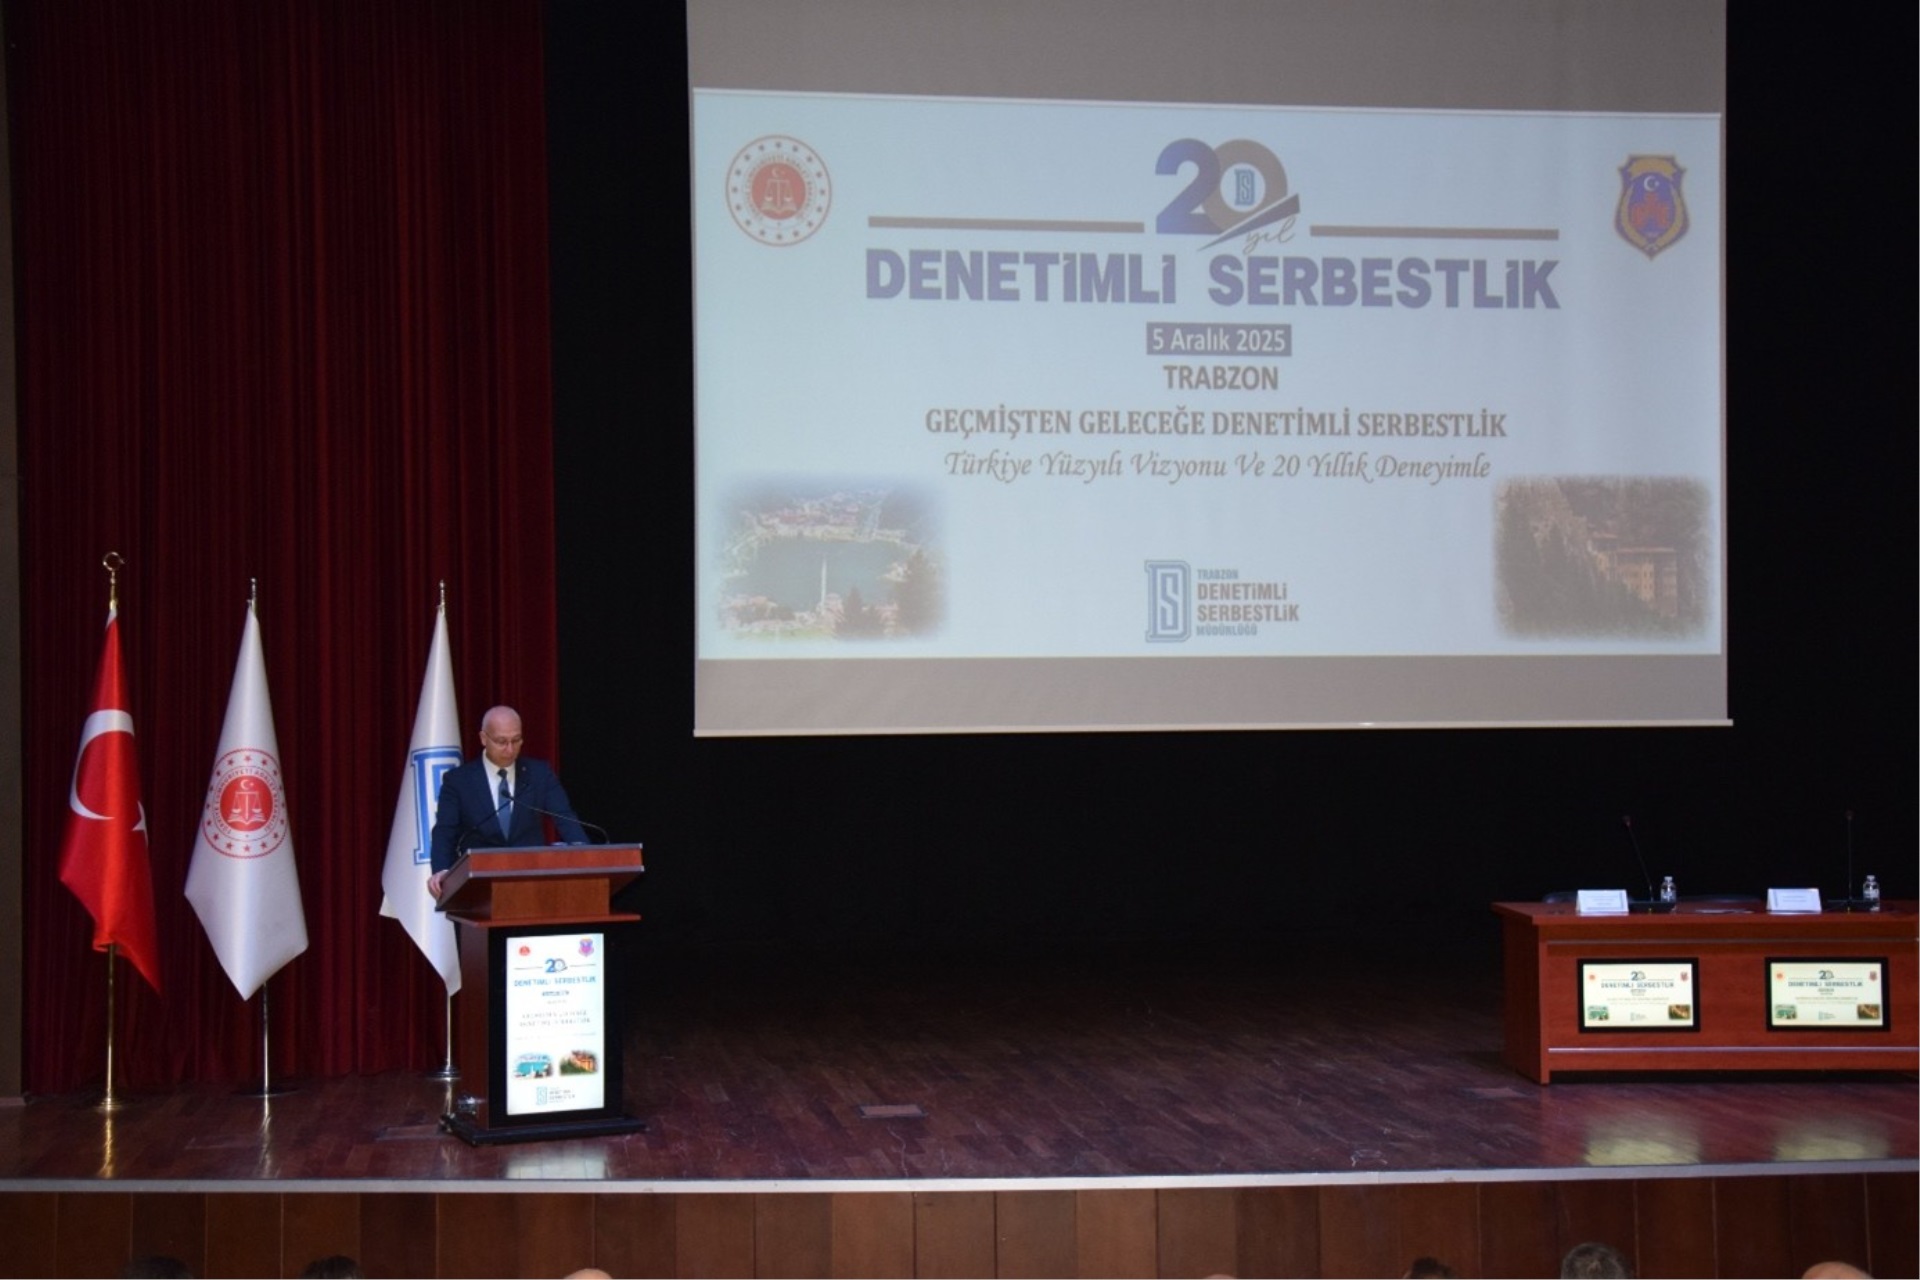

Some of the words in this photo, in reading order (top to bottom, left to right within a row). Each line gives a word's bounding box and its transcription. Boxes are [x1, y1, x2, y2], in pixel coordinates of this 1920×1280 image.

[1154, 137, 1289, 236] 20
[866, 248, 1177, 304] DENETİMLİ
[1207, 254, 1562, 309] SERBESTLİK
[1152, 327, 1165, 350] 5
[1170, 326, 1231, 351] Aralık
[1236, 329, 1286, 352] 2025
[1162, 364, 1279, 391] TRABZON
[925, 403, 1072, 440] GEÇMİŞTEN
[1078, 404, 1206, 436] GELECEĞE
[1212, 406, 1352, 437] DENETİMLİ
[1356, 407, 1508, 438] SERBESTLİK
[944, 448, 1033, 484] Türkiye
[1039, 449, 1124, 485] Yüzyılı
[1130, 450, 1227, 485] Vizyonu
[1234, 451, 1265, 477] Ve
[1272, 453, 1301, 478] 20
[1307, 451, 1374, 484] Yıllık
[1374, 452, 1492, 486] Deneyimle
[1197, 568, 1239, 581] TRABZON
